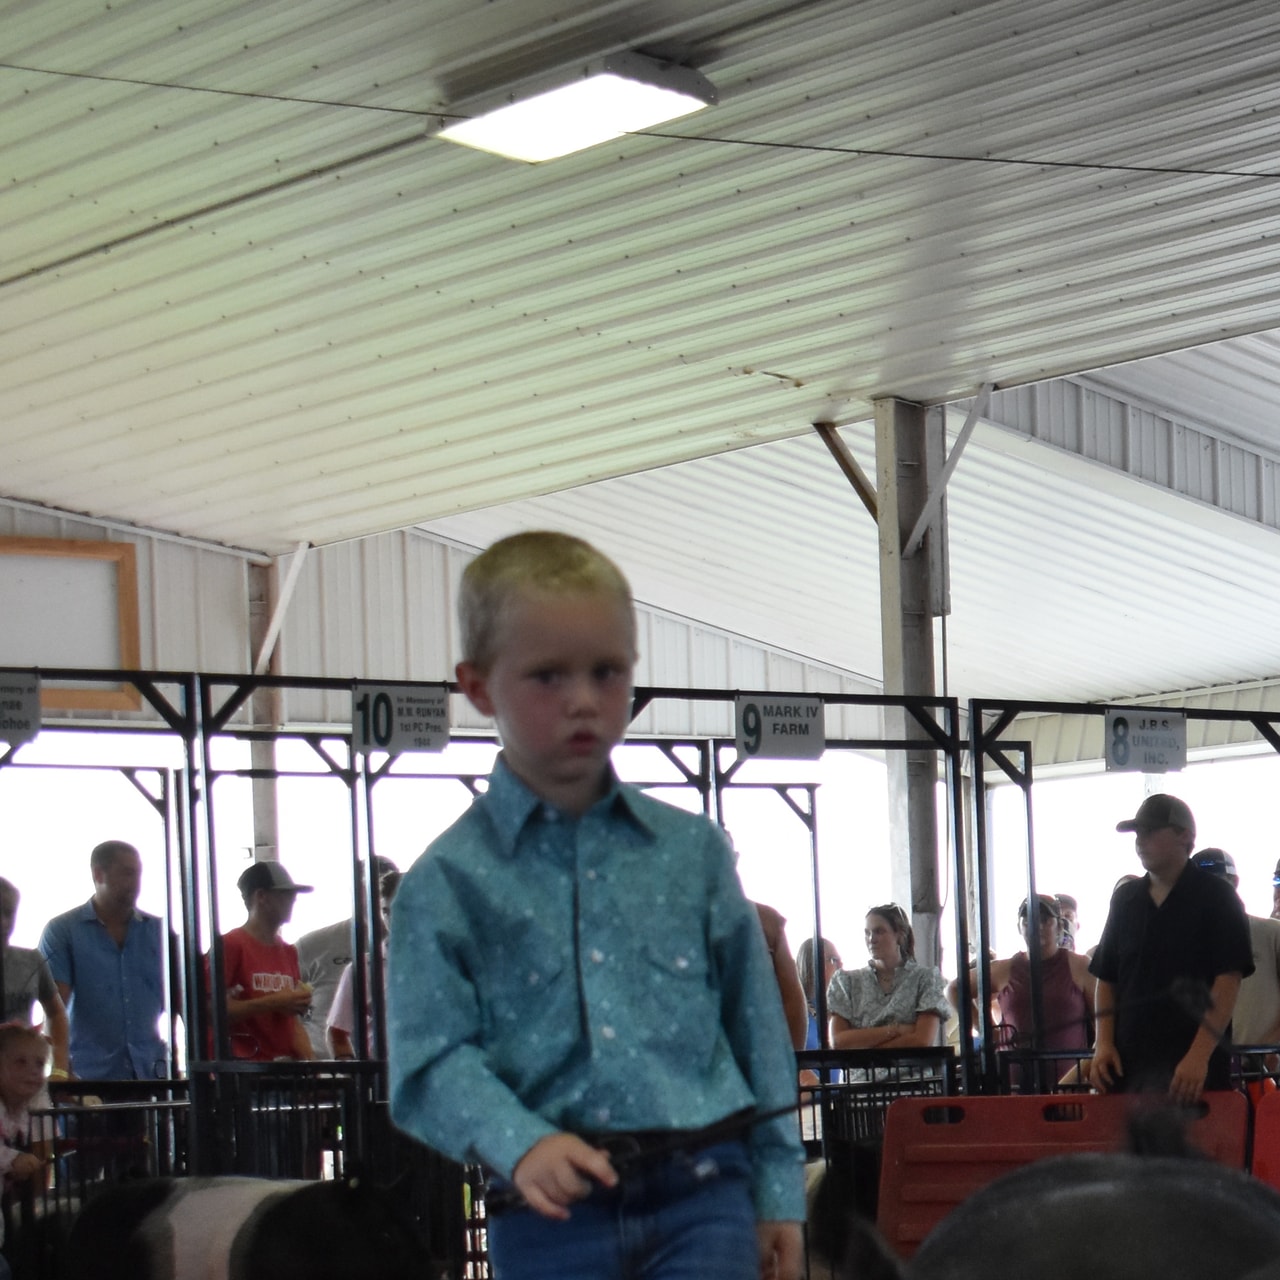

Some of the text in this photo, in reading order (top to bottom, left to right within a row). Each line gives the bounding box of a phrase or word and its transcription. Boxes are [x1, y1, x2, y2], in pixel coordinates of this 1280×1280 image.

[763, 705, 818, 718] MARK IV
[356, 692, 393, 747] 10
[1139, 719, 1172, 731] J.B.S.
[413, 722, 424, 733] PC
[743, 703, 761, 755] 9
[773, 723, 809, 735] FARM
[1112, 716, 1129, 766] 8
[1144, 752, 1169, 765] INC.
